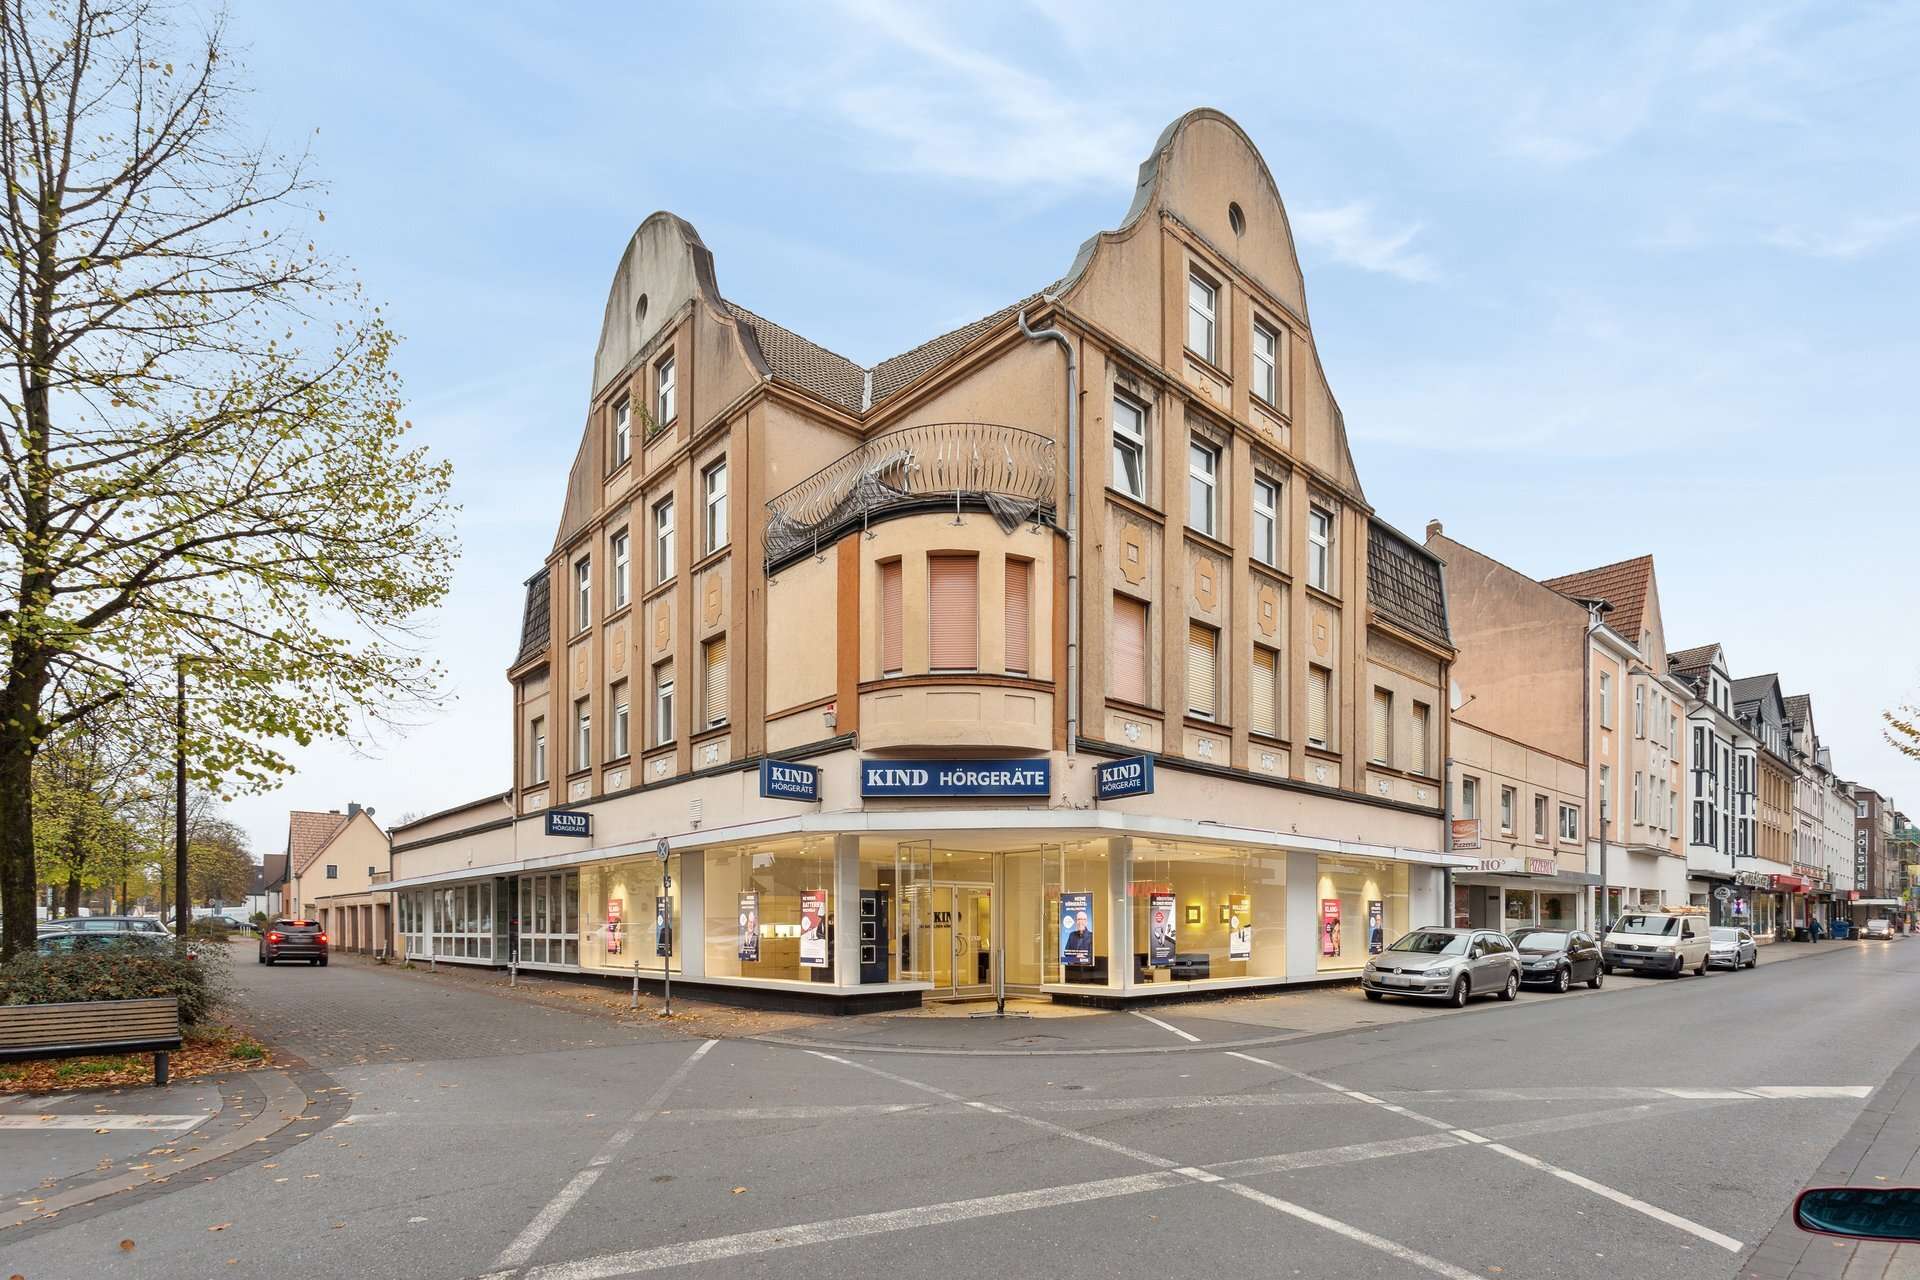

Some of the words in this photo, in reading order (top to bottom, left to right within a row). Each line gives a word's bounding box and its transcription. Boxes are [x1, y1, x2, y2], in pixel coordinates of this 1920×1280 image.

[771, 766, 813, 785] KIND
[867, 769, 929, 786] KIND
[939, 768, 1044, 786] HÖRGERÄTE
[1102, 763, 1141, 783] KIND
[771, 781, 813, 794] HÖRGERÄTE
[1102, 778, 1141, 792] HÖRGERÄTE
[552, 814, 586, 826] KIND
[1856, 830, 1866, 890] POLSTER
